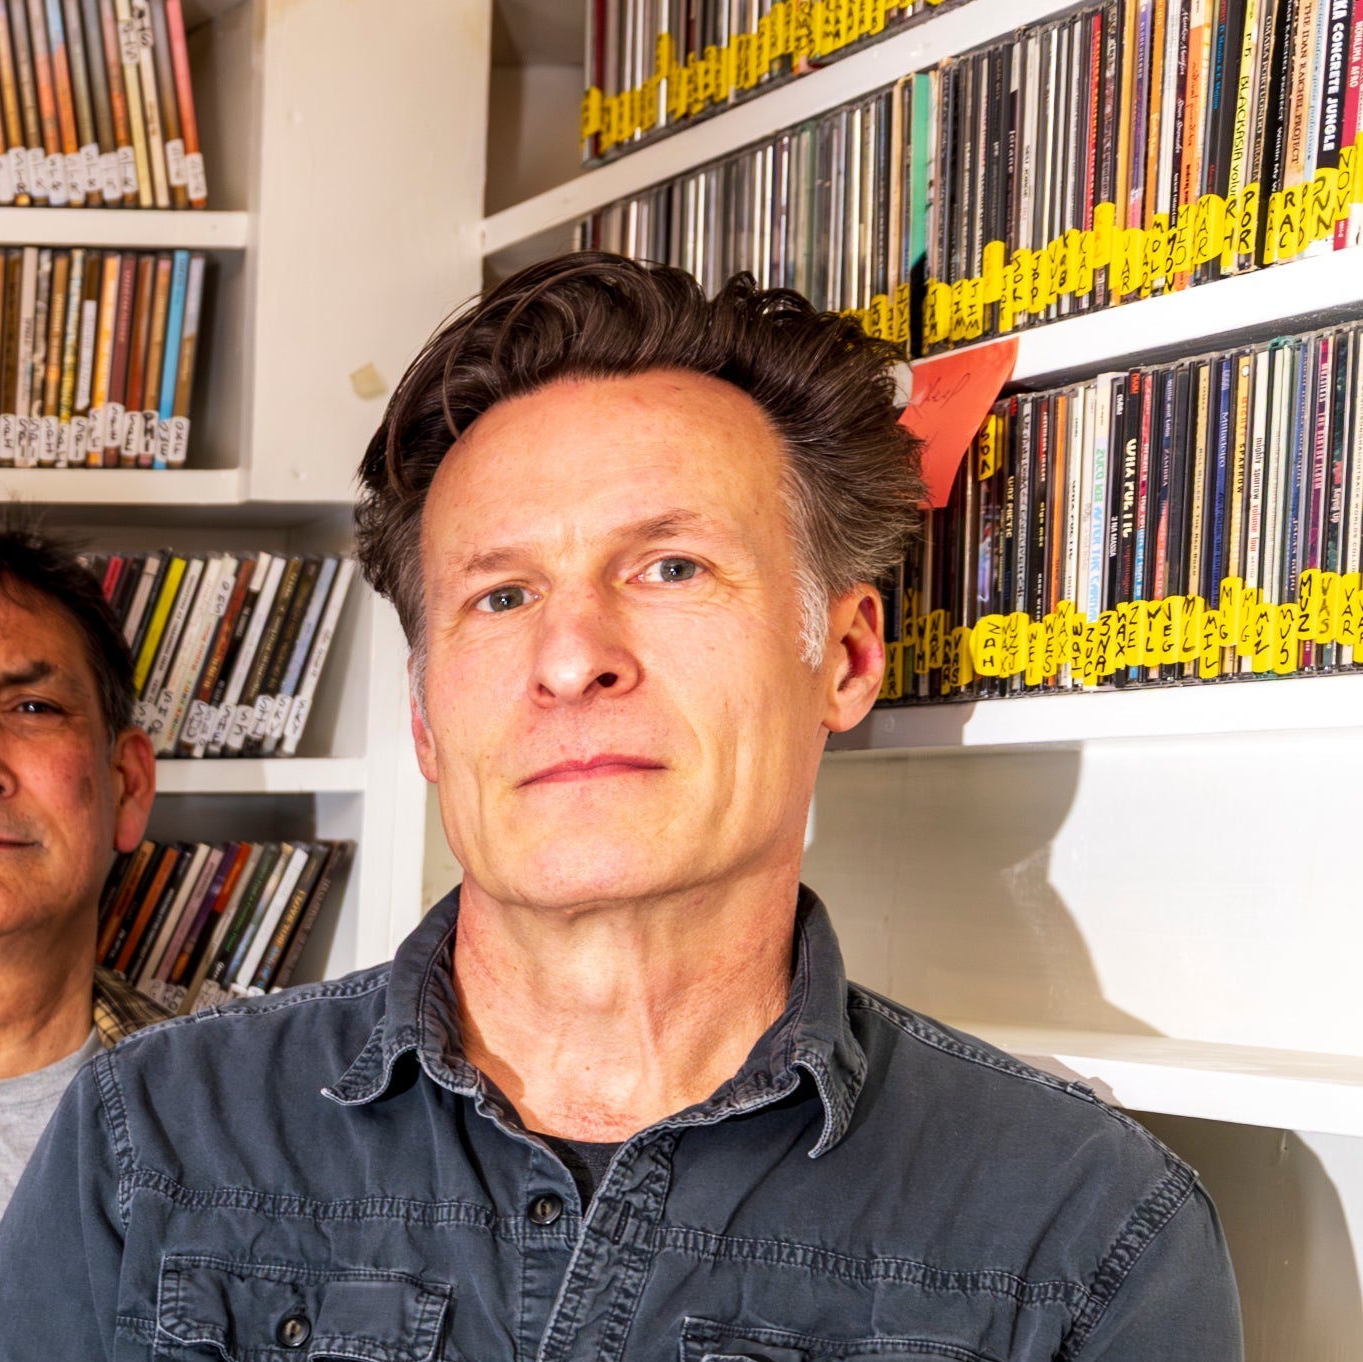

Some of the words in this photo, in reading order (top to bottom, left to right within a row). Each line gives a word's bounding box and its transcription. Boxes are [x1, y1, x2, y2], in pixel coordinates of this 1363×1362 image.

[1327, 23, 1344, 93] CONCRETE
[1351, 21, 1363, 63] NOVALIMA
[1349, 66, 1360, 87] AFRO
[1323, 97, 1339, 151] JUNGLE
[1238, 190, 1255, 250] POR
[1236, 444, 1245, 494] SPARROW
[1253, 437, 1264, 464] mighty
[1252, 469, 1261, 500] sparrow
[1250, 505, 1260, 533] volume
[1298, 573, 1313, 632] MUZ
